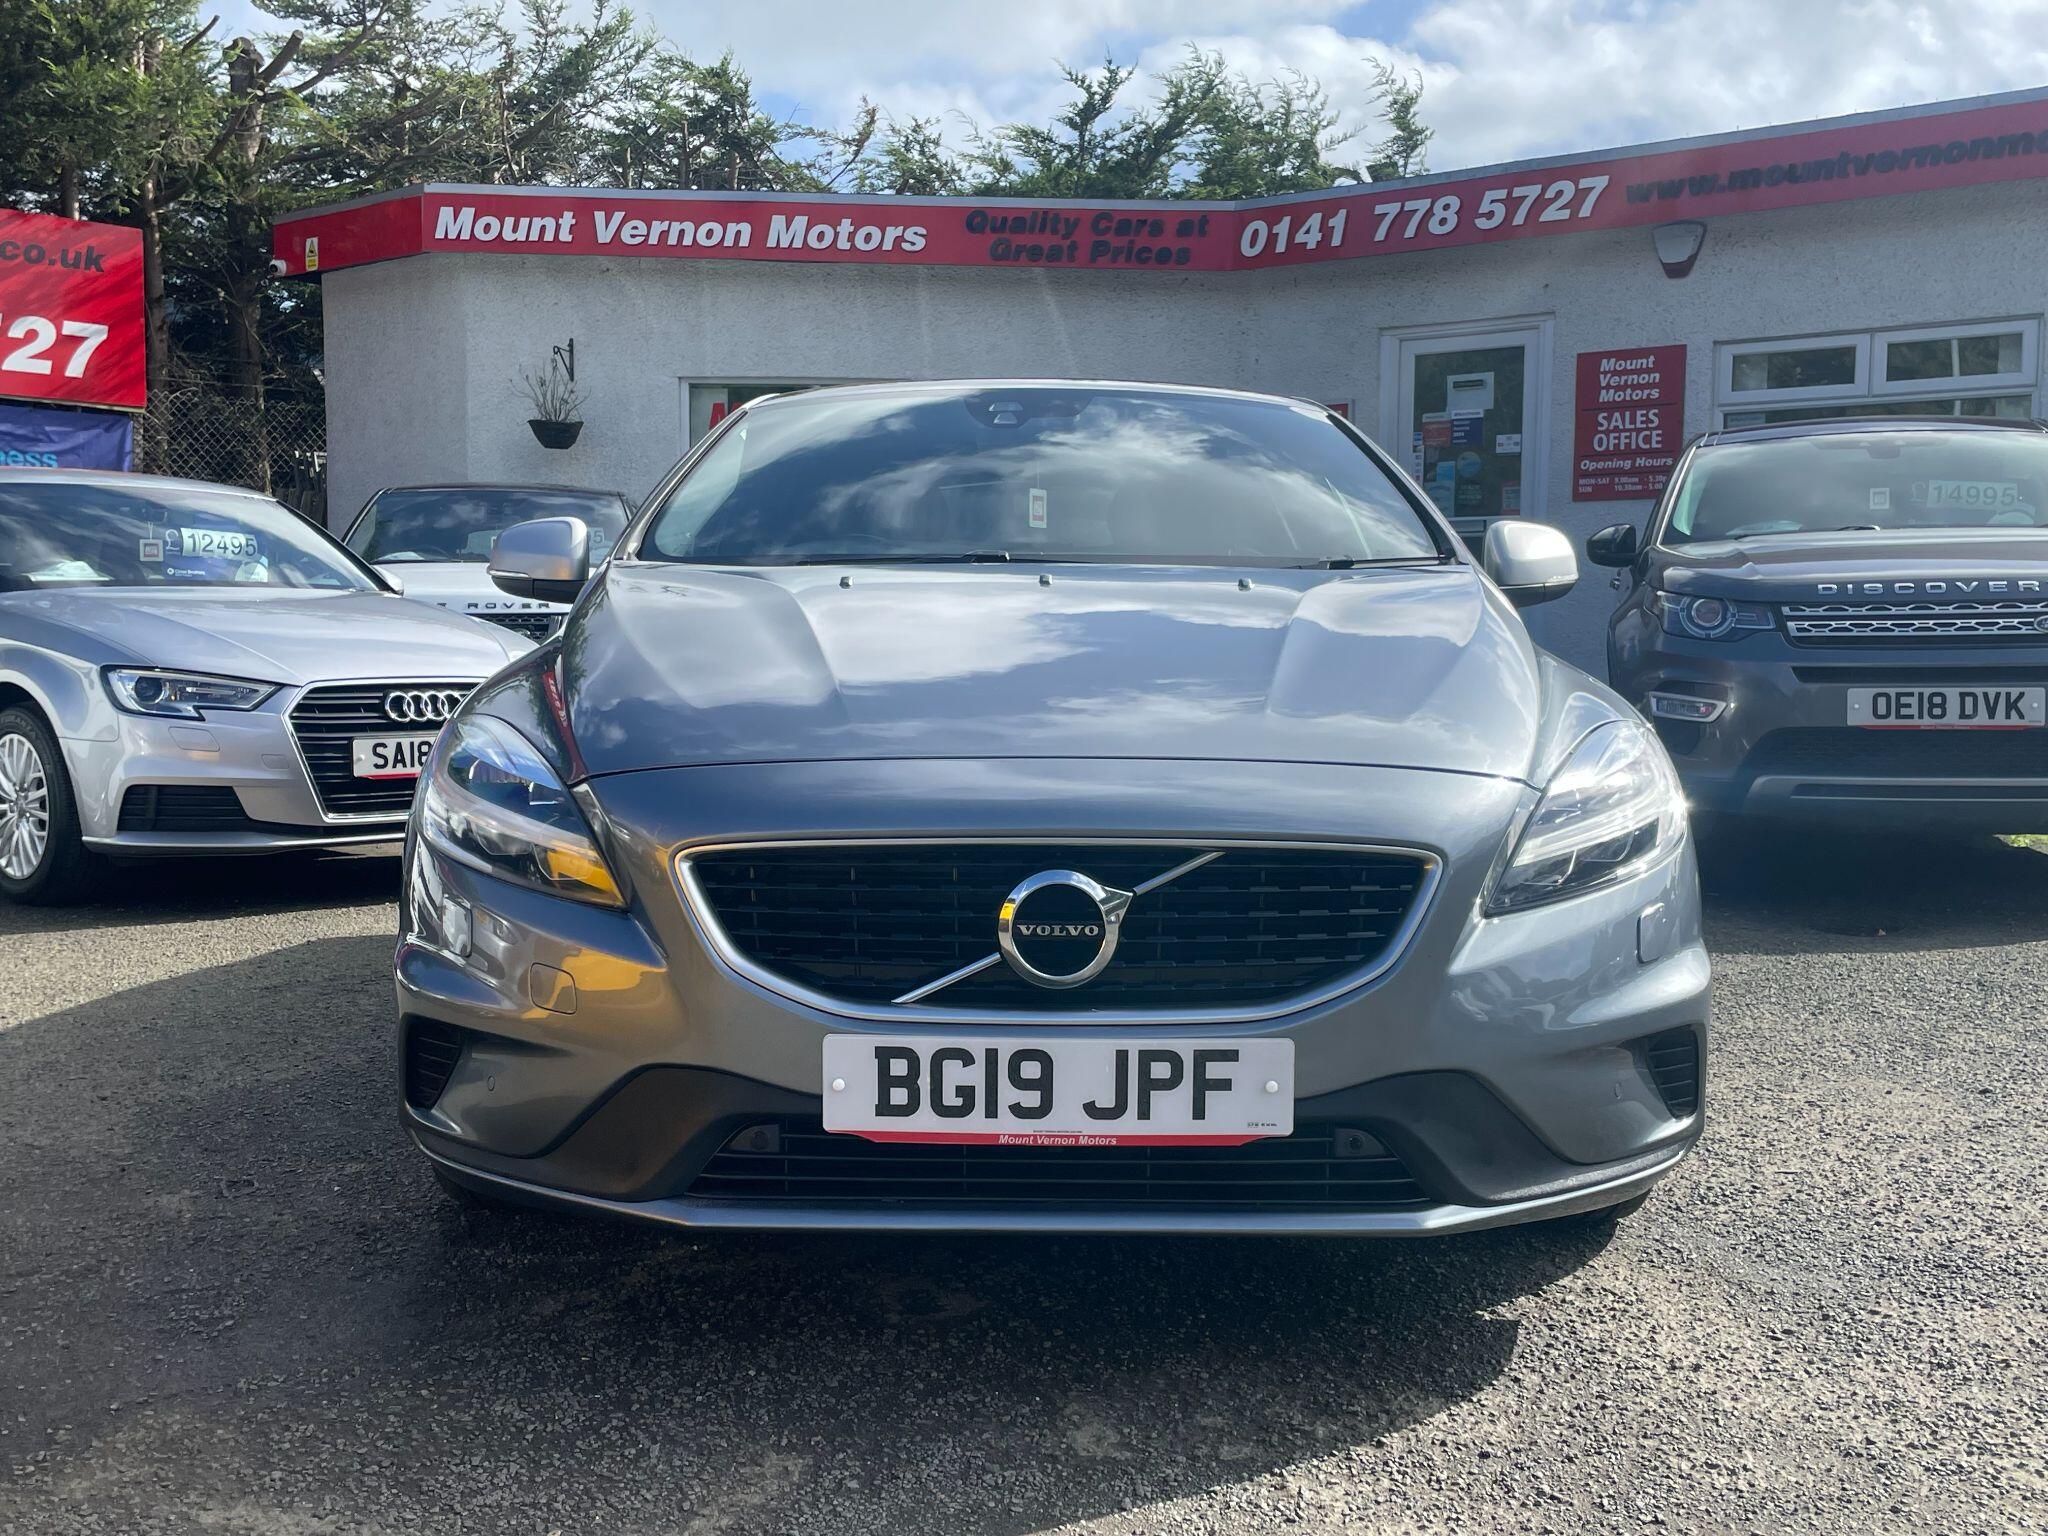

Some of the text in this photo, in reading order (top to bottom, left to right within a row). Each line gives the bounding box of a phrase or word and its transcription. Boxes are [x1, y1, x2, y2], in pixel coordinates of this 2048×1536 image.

[965, 209, 1210, 240] Quality Cars at
[1240, 175, 1610, 258] 0141 778 5727
[434, 206, 929, 253] Mount Vernon Motors
[989, 236, 1192, 266] Great Prices
[0, 313, 109, 378] 27
[1600, 355, 1656, 372] Mount
[1599, 372, 1661, 387] Vernon
[1599, 388, 1660, 403] Motors
[1597, 409, 1659, 431] SALES
[1593, 430, 1663, 451] OFFICE
[1580, 457, 1673, 471] Opening Hours
[1817, 580, 2048, 595] DISCOVER
[467, 602, 550, 610] ROVER
[1872, 691, 2026, 720] OE18 DVK
[372, 740, 432, 770] SA18
[1017, 924, 1099, 936] VOLVO
[874, 1046, 1240, 1122] BG19 JPF
[998, 1134, 1117, 1146] Mount Vernon Motors
